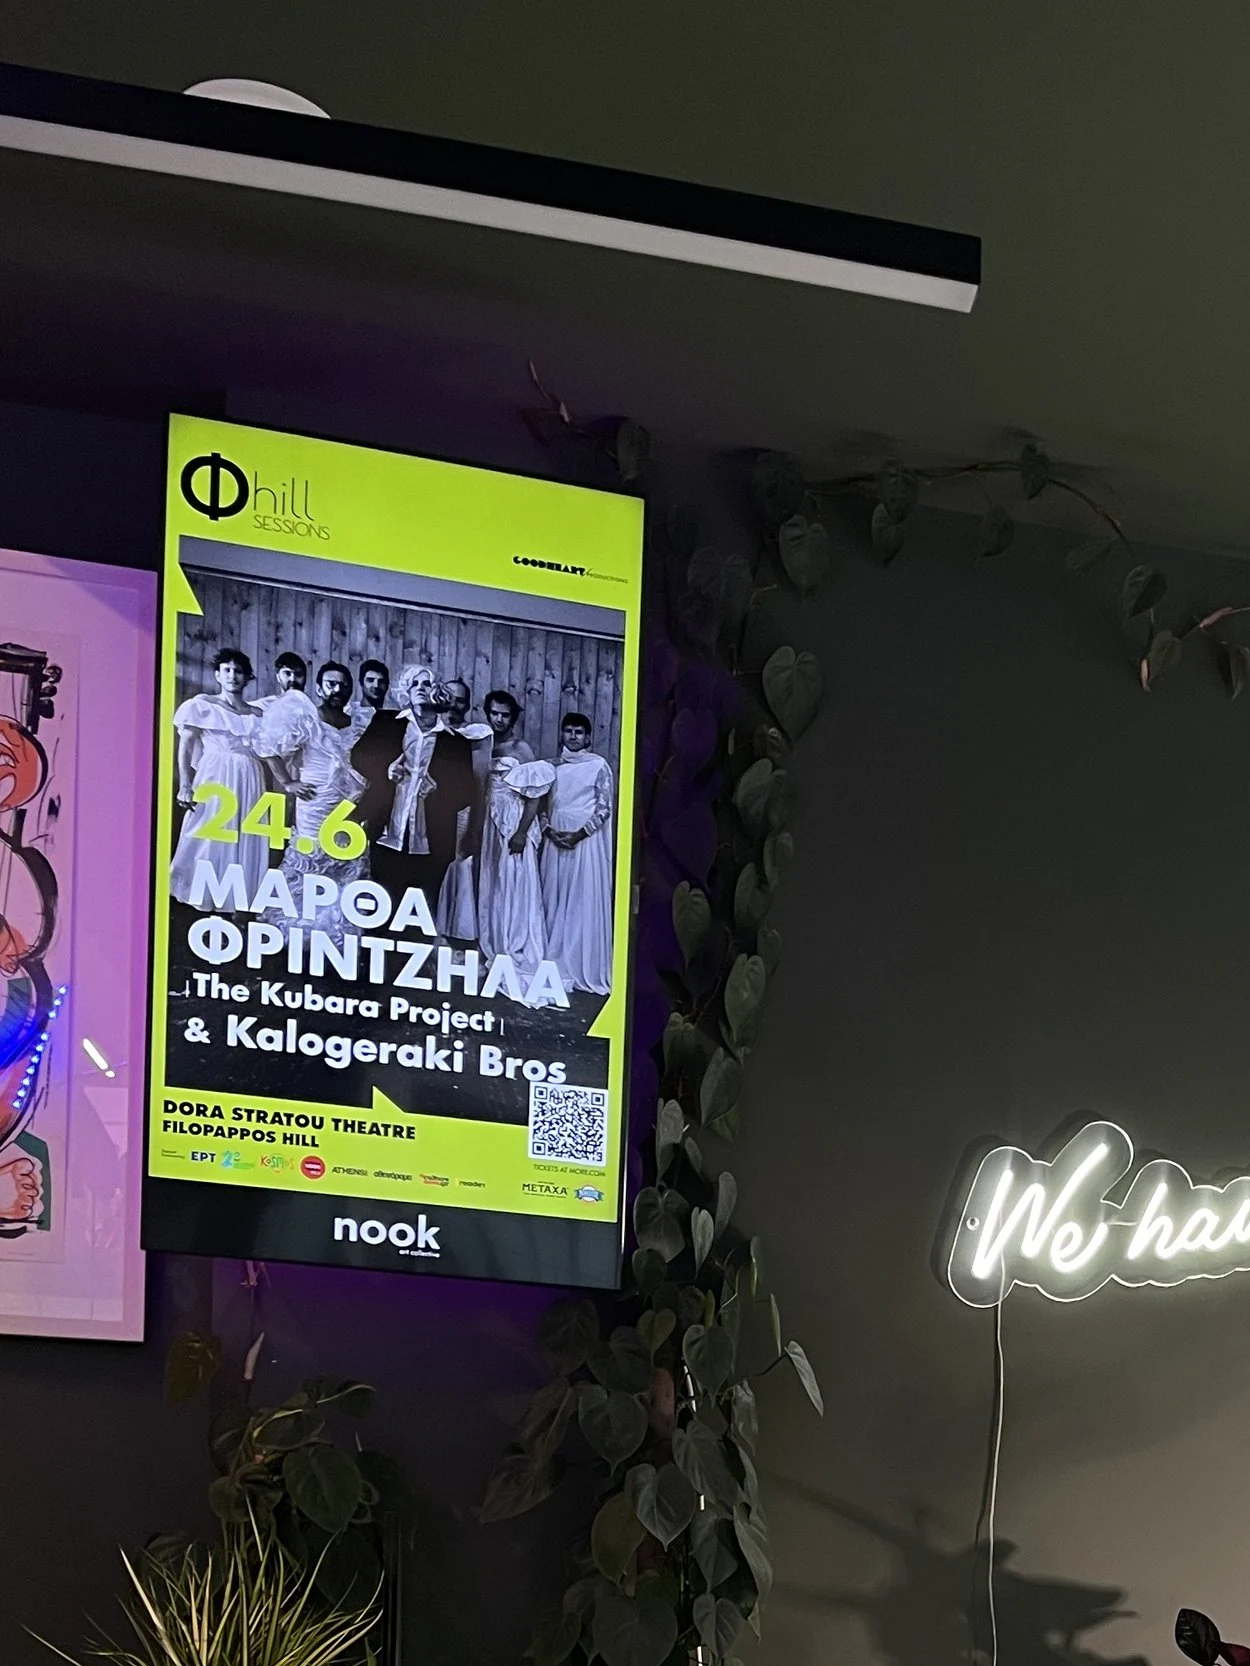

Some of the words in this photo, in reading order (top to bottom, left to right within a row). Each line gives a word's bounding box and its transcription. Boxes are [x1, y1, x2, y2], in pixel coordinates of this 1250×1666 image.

[253, 515, 330, 541] SESSIONS
[192, 783, 368, 861] 24.6
[188, 859, 438, 937] ΜΑΡΘΑ
[187, 916, 571, 1008] ΦΡΙΝΤΖΗΛΑ
[193, 971, 250, 1003] The
[261, 980, 380, 1019] Kubara
[390, 996, 495, 1035] Project
[184, 1017, 211, 1044] &
[226, 1014, 464, 1073] Kalogeraki
[479, 1044, 567, 1084] Bros
[162, 1120, 276, 1143] FILOPAPPOS
[282, 1133, 319, 1148] HILL
[163, 1099, 225, 1119] DORA
[231, 1107, 325, 1130] STRATOU
[331, 1118, 416, 1140] THEATRE
[522, 1183, 568, 1196] METAXA
[970, 1142, 1109, 1280] We
[333, 1214, 440, 1250] nook
